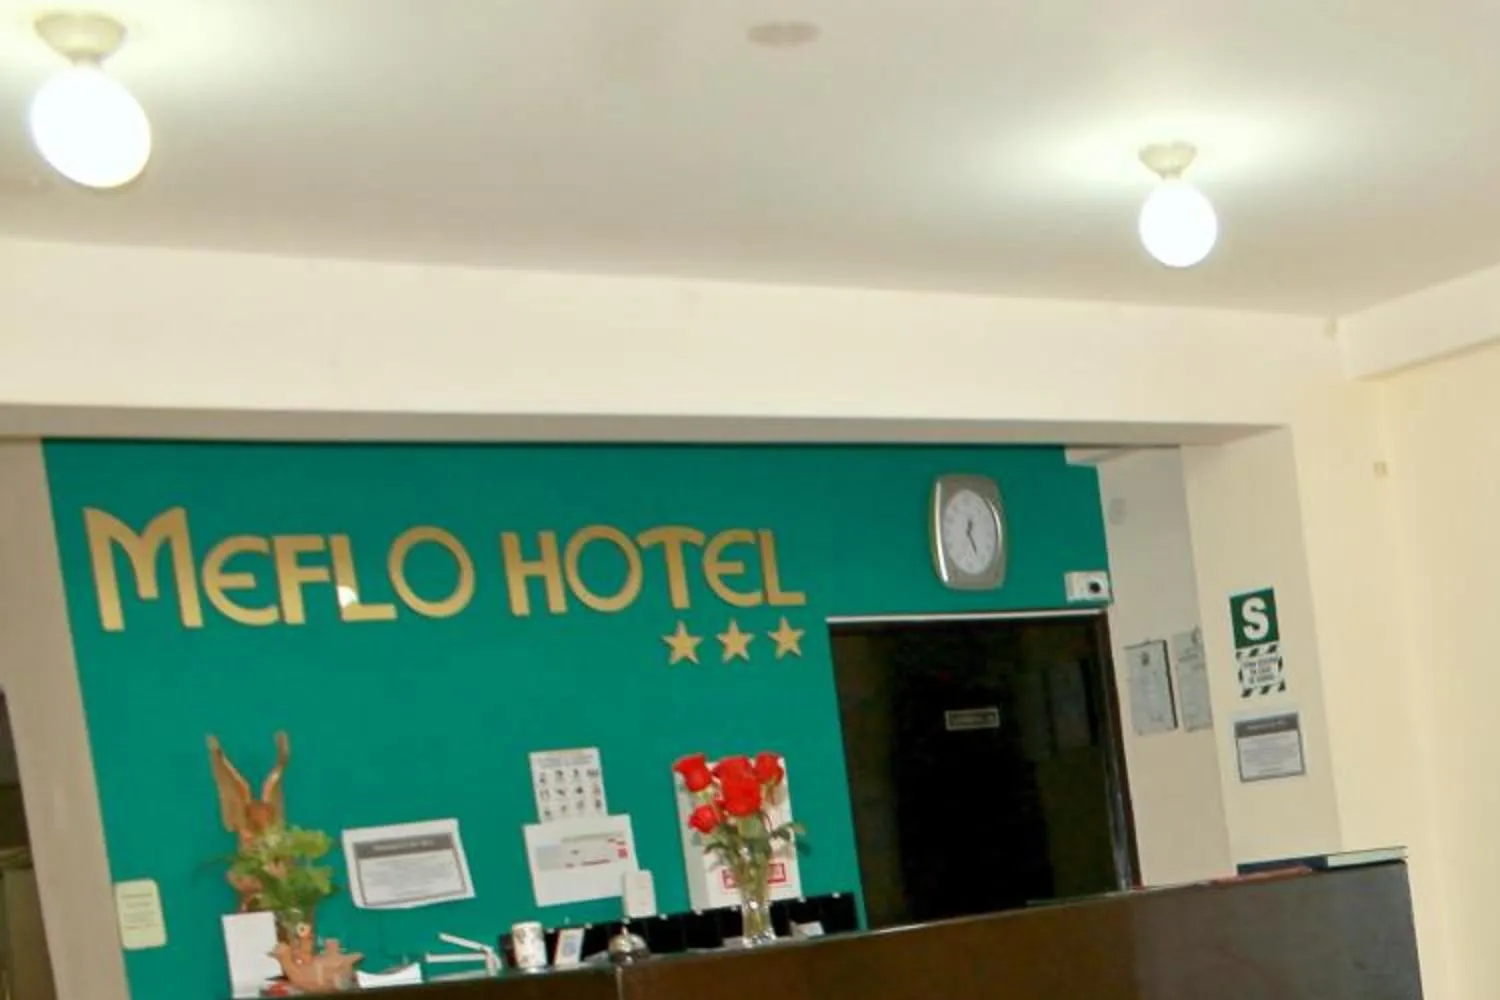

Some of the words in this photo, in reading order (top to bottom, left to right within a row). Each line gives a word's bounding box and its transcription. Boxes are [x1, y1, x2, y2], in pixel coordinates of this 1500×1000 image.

[83, 506, 476, 631] MEFLO
[501, 524, 806, 616] HOTEL
[1242, 597, 1269, 640] S
